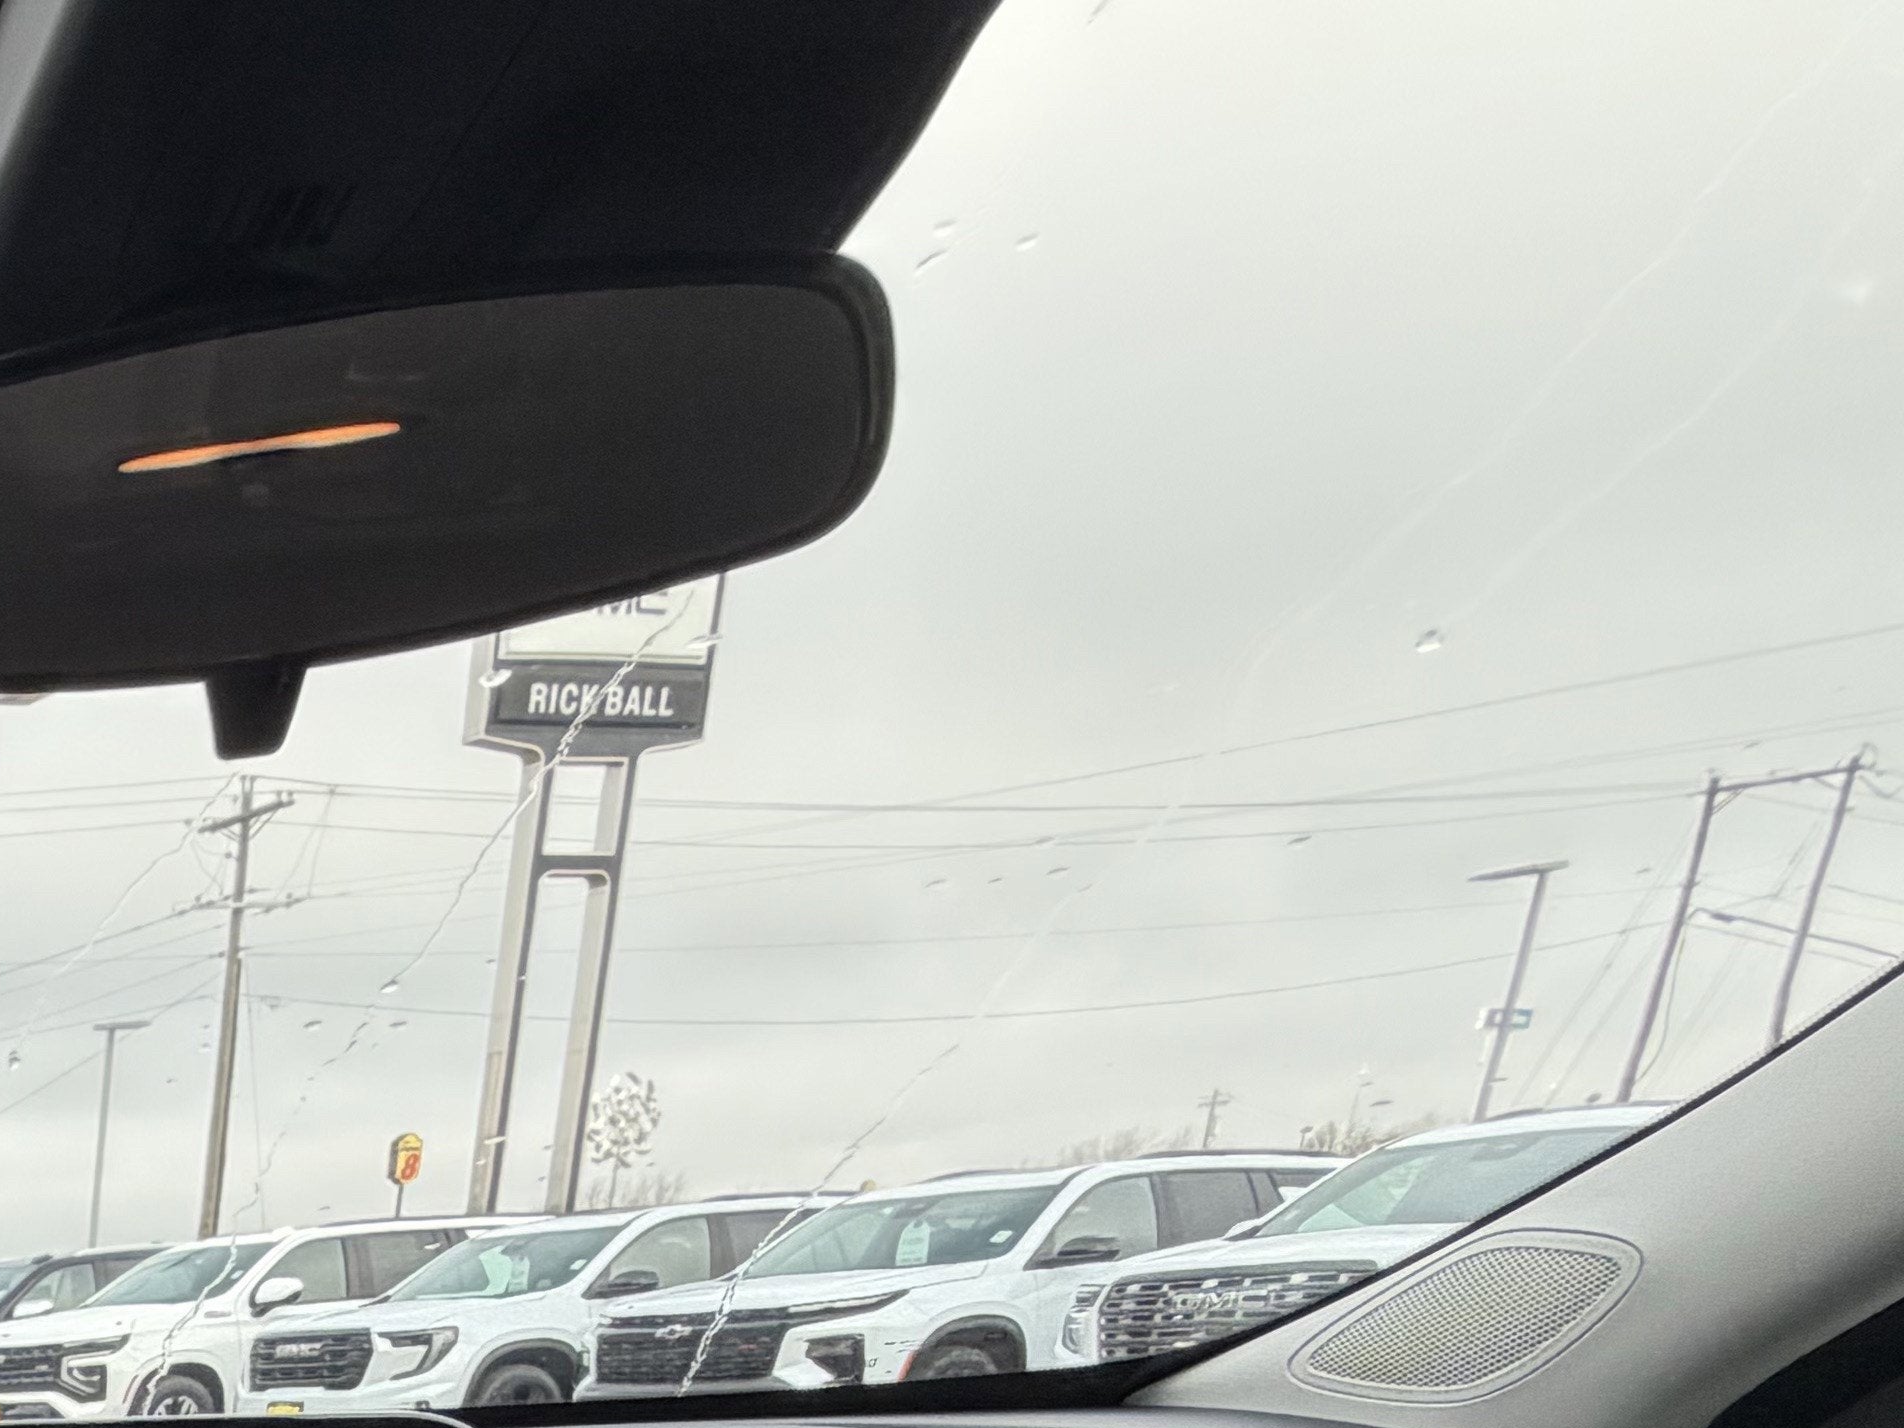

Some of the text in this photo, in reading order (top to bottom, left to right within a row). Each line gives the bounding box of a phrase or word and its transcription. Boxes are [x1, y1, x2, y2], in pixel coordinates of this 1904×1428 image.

[527, 682, 675, 718] RICK BALL
[401, 1153, 420, 1181] 8
